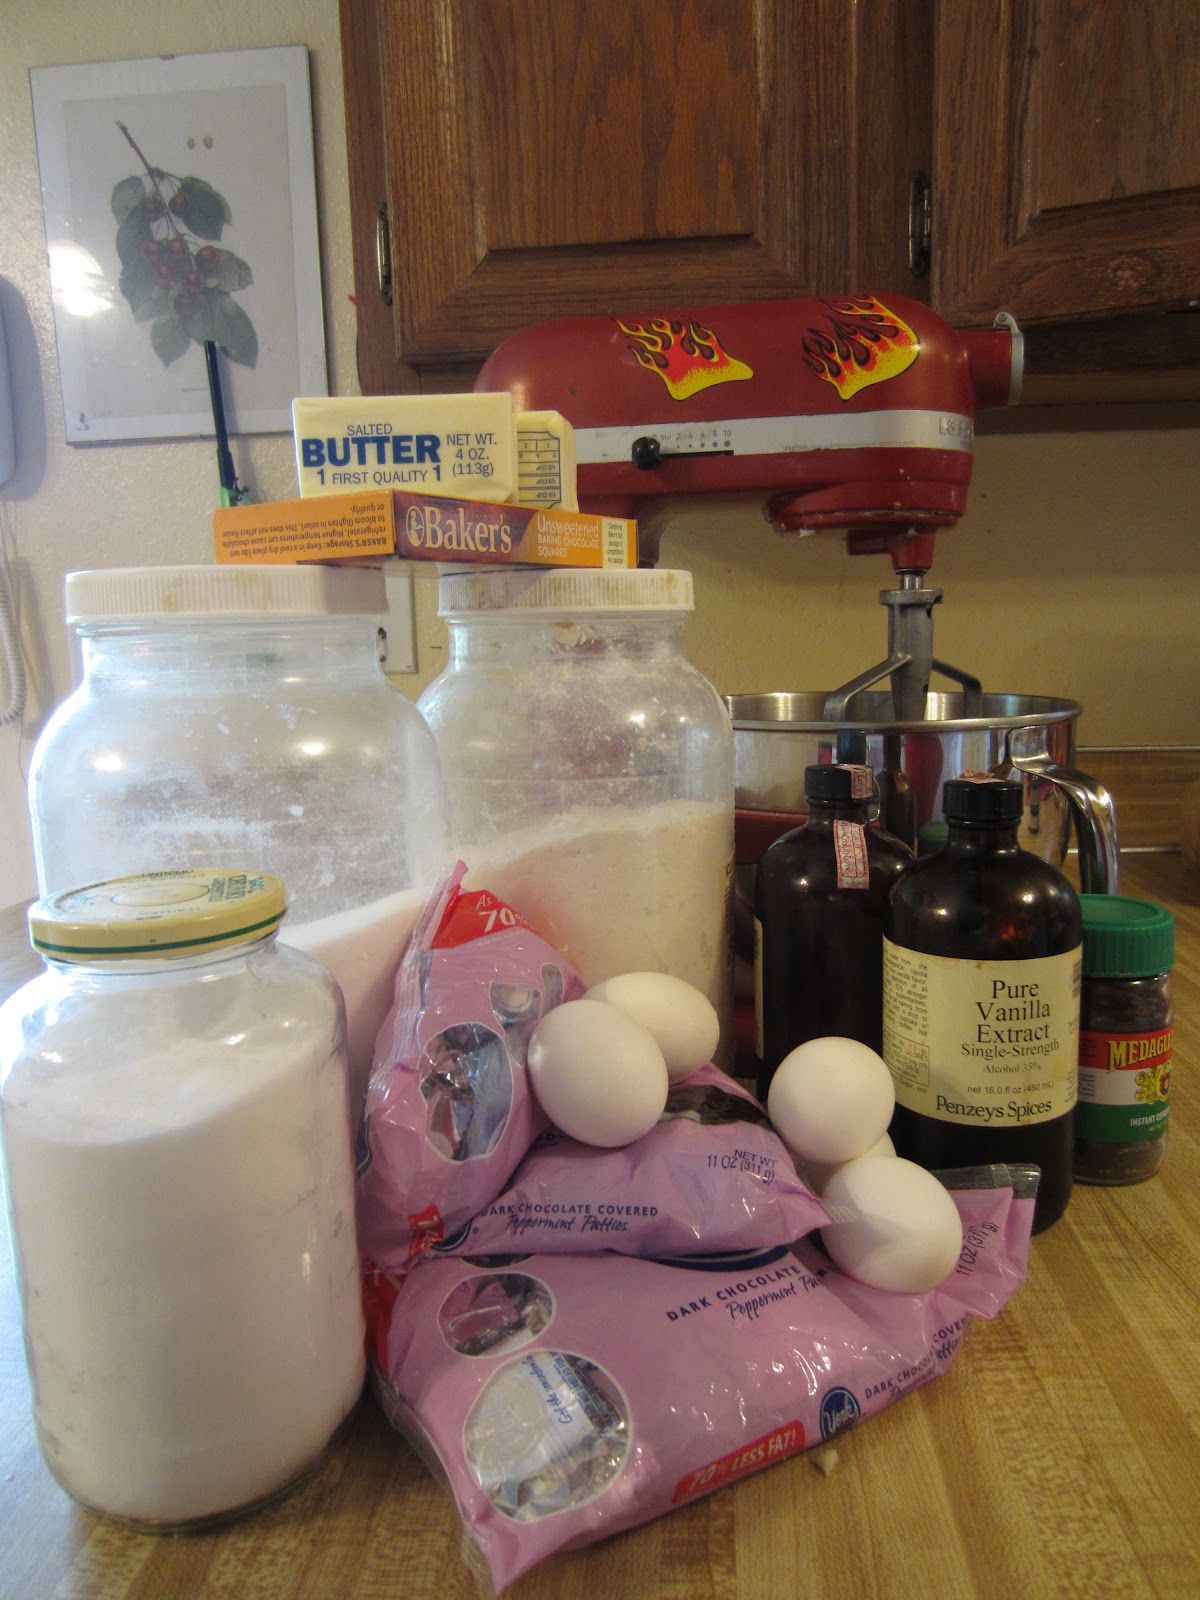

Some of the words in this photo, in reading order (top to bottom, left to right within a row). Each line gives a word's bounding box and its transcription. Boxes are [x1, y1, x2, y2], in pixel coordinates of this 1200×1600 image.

[347, 424, 392, 436] SALTED
[447, 435, 471, 446] NET
[475, 433, 497, 445] WT.
[302, 435, 441, 467] BUTTER
[456, 449, 463, 460] 4
[468, 448, 489, 460] OZ.
[317, 470, 325, 484] 1
[333, 472, 368, 484] FIRST
[373, 470, 427, 485] QUALITY
[433, 465, 441, 480] 1
[452, 463, 494, 477] (113g)
[328, 517, 353, 528] (lighten
[355, 516, 376, 526] bloom
[538, 515, 599, 538] Unsweetened
[222, 530, 239, 538] flavor
[240, 528, 257, 536] affect
[258, 527, 268, 535] not
[270, 525, 284, 534] does
[285, 524, 297, 532] This
[322, 528, 343, 540] Higher
[424, 506, 511, 554] Baker's
[251, 537, 267, 545] cause
[279, 531, 320, 542] temperatures
[355, 537, 387, 548] BAKER'S
[538, 535, 562, 545] BAKING
[564, 536, 599, 548] CHOCOLATE
[222, 539, 249, 548] chocolate
[280, 545, 293, 553] cool
[306, 541, 322, 550] Keep
[323, 540, 354, 549] Storage:
[252, 546, 267, 555] place
[269, 546, 279, 554] dry
[538, 547, 568, 557] SQUARES
[992, 980, 1039, 999] Pure
[976, 1000, 1050, 1021] Vanilla
[977, 1024, 1050, 1044] Extract
[961, 1038, 1059, 1061] Single-Strength
[1107, 1032, 1173, 1073] MEDAGLI
[984, 1064, 1020, 1074] Alcohol
[937, 1095, 1004, 1121] Penzeys
[1007, 1100, 1052, 1121] Spices
[1130, 1116, 1155, 1126] INSTANT
[708, 1155, 716, 1168] 11
[722, 1156, 737, 1169] OZ
[735, 1149, 757, 1162] NET
[760, 1156, 777, 1168] WT
[481, 1204, 514, 1216] DARK
[518, 1204, 592, 1215] CHOCOLATE
[598, 1205, 658, 1217] COVERED
[507, 1215, 575, 1236] Peppermint
[580, 1215, 629, 1233] Patties
[960, 1245, 978, 1264] OZ
[956, 1264, 972, 1275] 11
[666, 1296, 711, 1321] DARK
[716, 1264, 801, 1301] CHOCOLATE
[726, 1283, 796, 1321] Peppermint
[865, 1378, 893, 1398] DARK
[933, 1317, 965, 1342] COVE
[731, 1444, 765, 1473] LESS
[767, 1429, 798, 1459] FAT!
